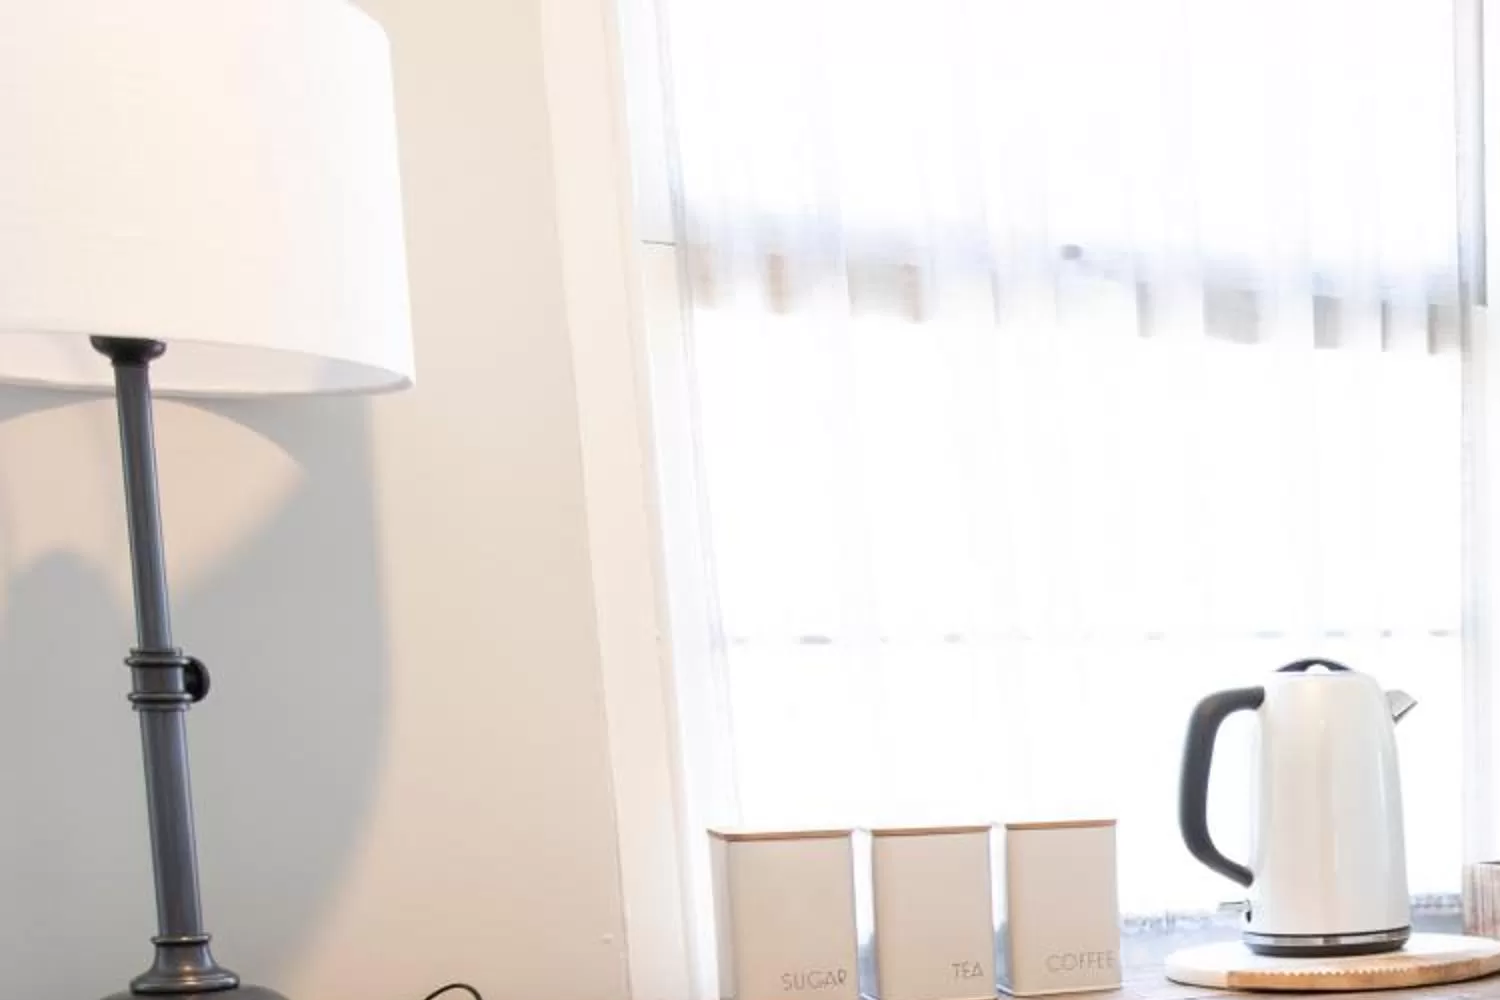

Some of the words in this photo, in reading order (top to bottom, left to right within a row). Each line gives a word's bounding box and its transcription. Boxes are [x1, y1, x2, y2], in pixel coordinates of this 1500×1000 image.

[951, 962, 985, 980] TEA
[1044, 950, 1117, 975] COFFEE
[780, 968, 848, 992] SUGAR
